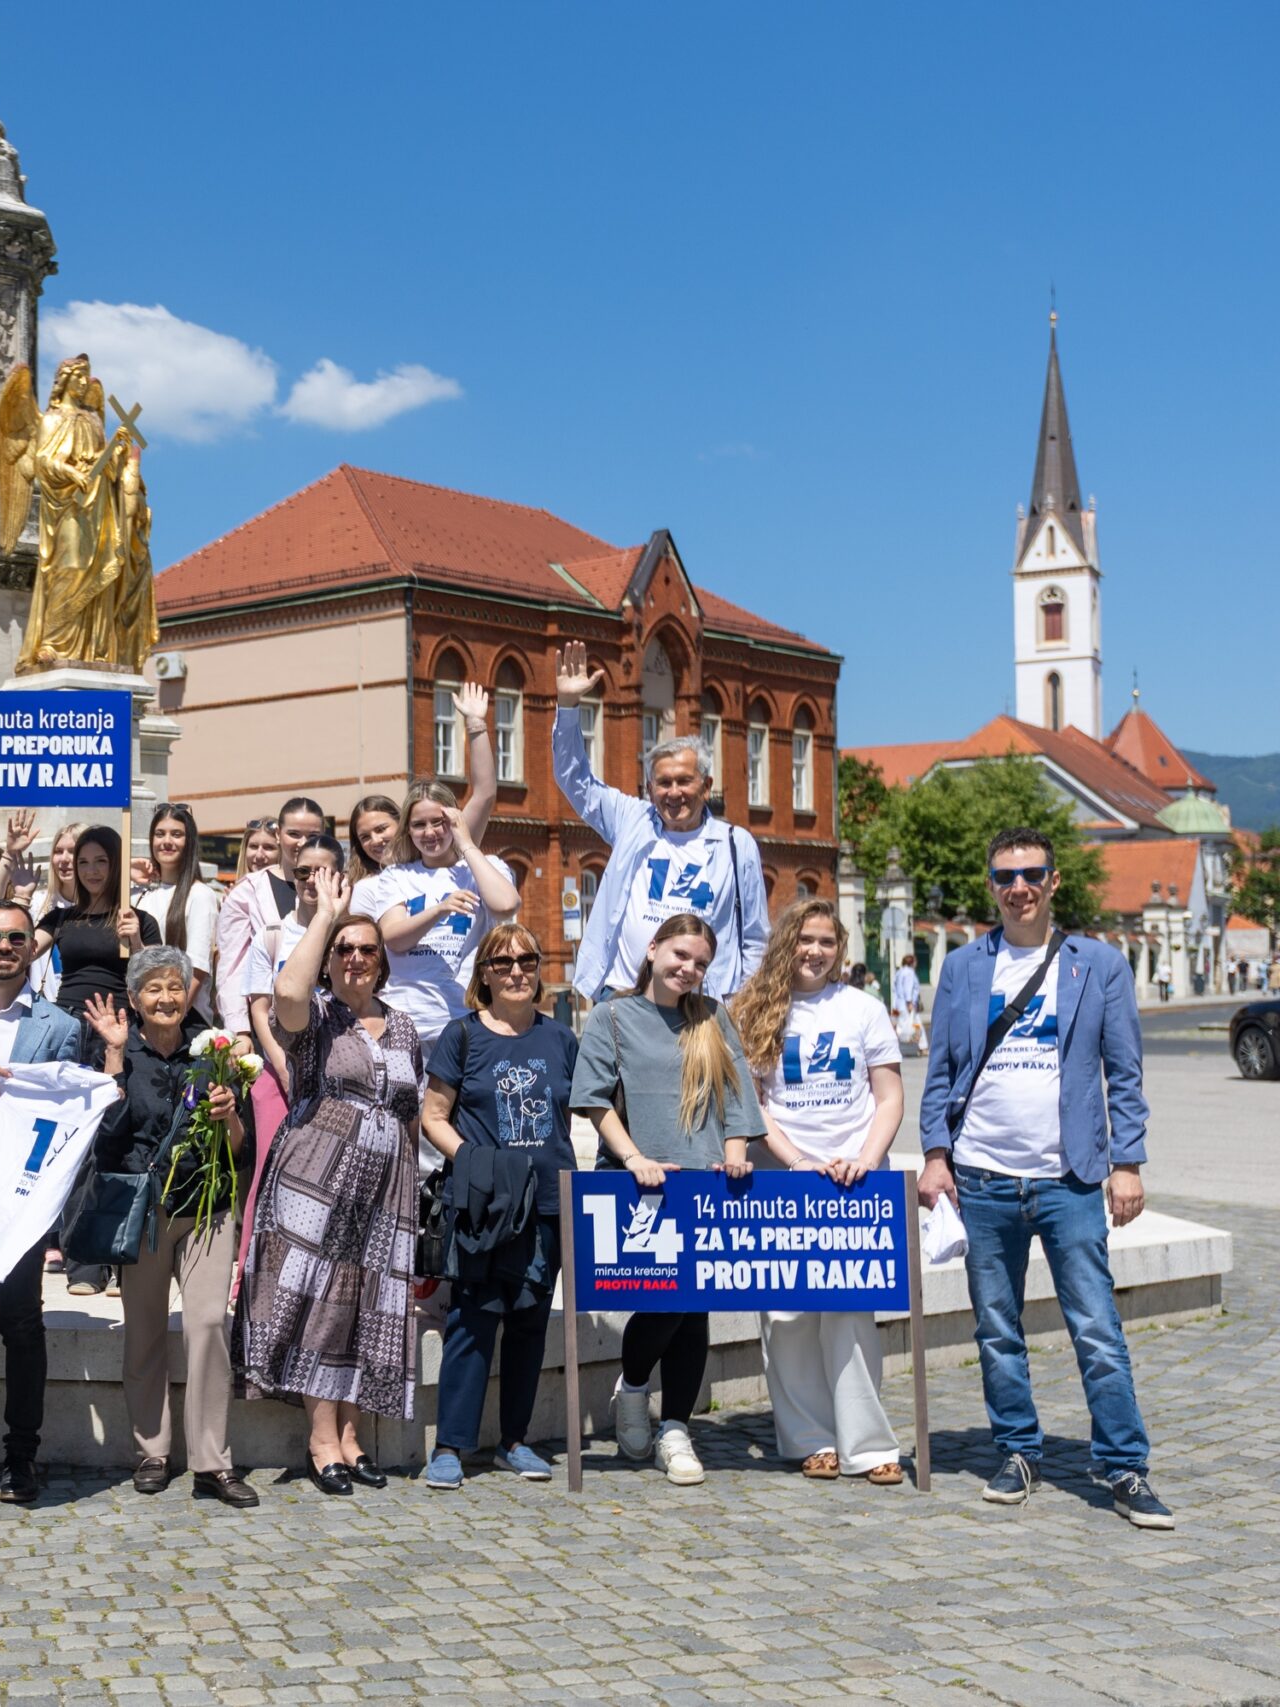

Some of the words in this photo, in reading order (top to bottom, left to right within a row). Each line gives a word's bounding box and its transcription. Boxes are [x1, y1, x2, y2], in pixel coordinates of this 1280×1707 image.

[39, 708, 114, 734] kretanja
[1, 735, 114, 755] PREPORUKA
[38, 763, 114, 787] RAKA!
[647, 858, 714, 910] 14
[782, 1031, 856, 1085] 14
[693, 1194, 716, 1219] 14
[722, 1194, 797, 1219] minuta
[804, 1193, 893, 1225] kretanja
[582, 1193, 684, 1264] 14
[694, 1227, 724, 1251] ZA
[729, 1228, 756, 1251] 14
[761, 1226, 894, 1251] PREPORUKA
[594, 1266, 632, 1276] minuta
[634, 1265, 678, 1278] kretanja
[696, 1260, 799, 1290] PROTIV
[806, 1259, 896, 1290] RAKA!
[594, 1280, 640, 1291] PROTIV
[643, 1280, 678, 1291] RAKA
